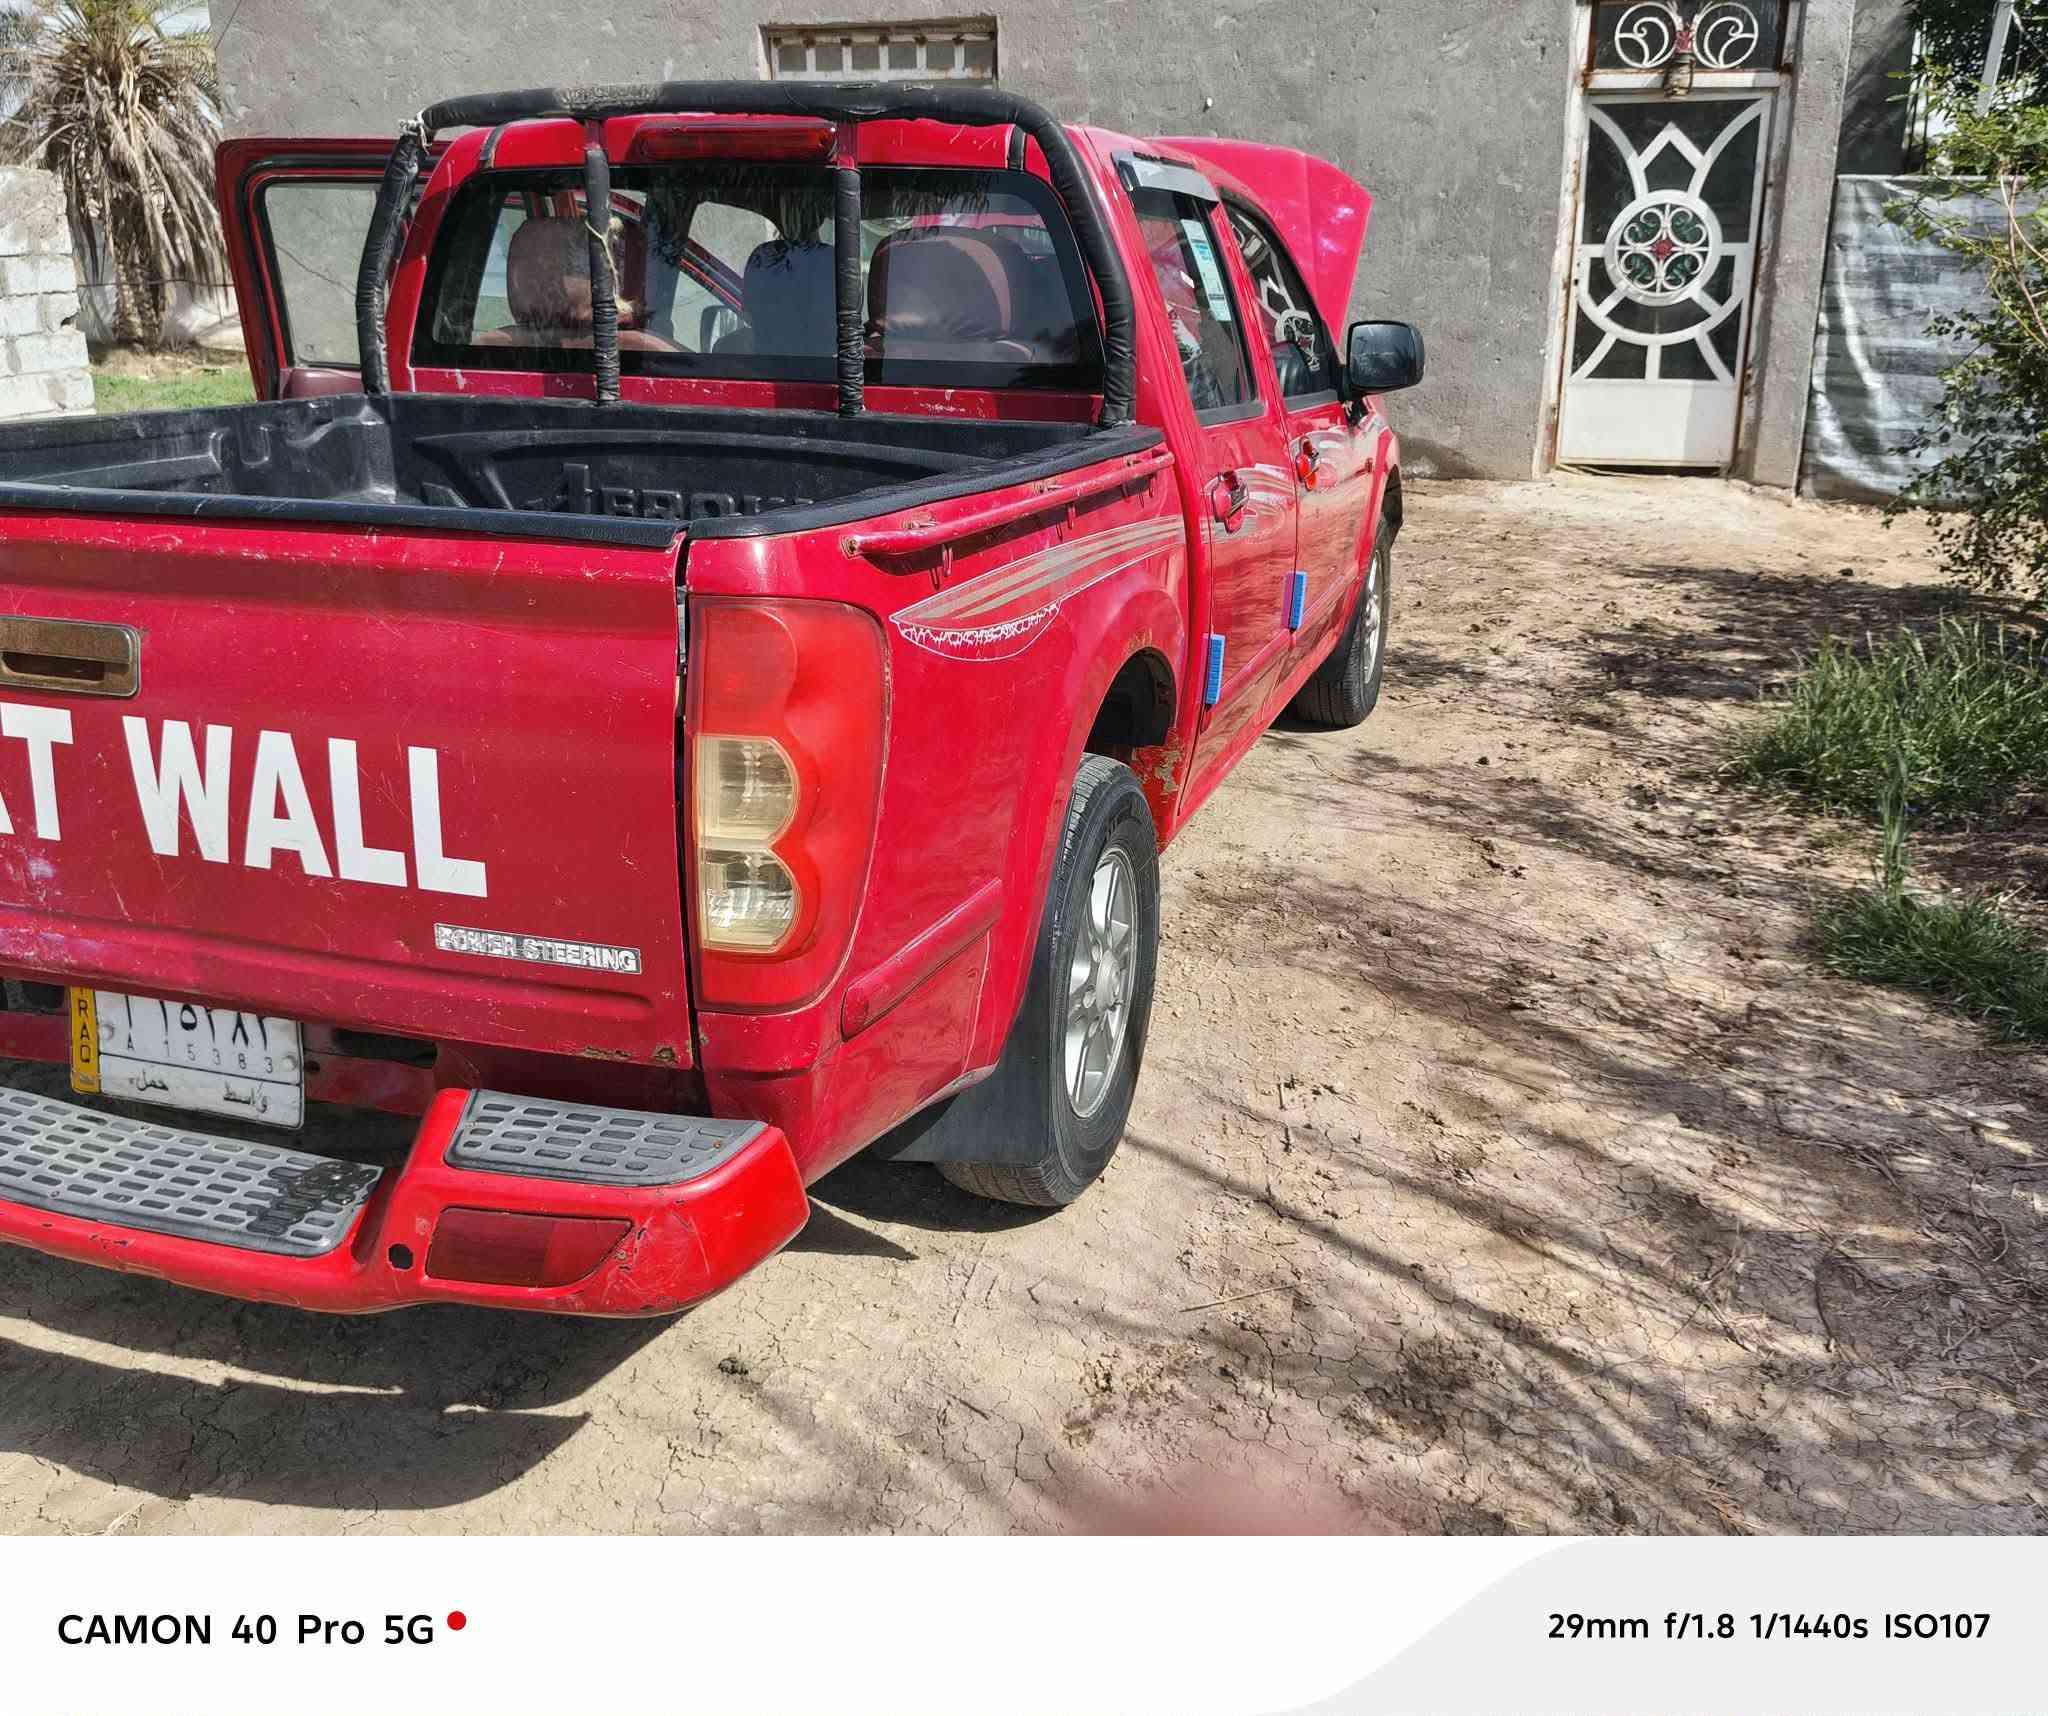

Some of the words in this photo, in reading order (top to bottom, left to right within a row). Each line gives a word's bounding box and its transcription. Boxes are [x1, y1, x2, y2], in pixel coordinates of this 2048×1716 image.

[0, 702, 74, 841] T
[122, 715, 488, 898] WALL
[437, 926, 517, 957] POWER
[523, 938, 637, 971] STEERING
